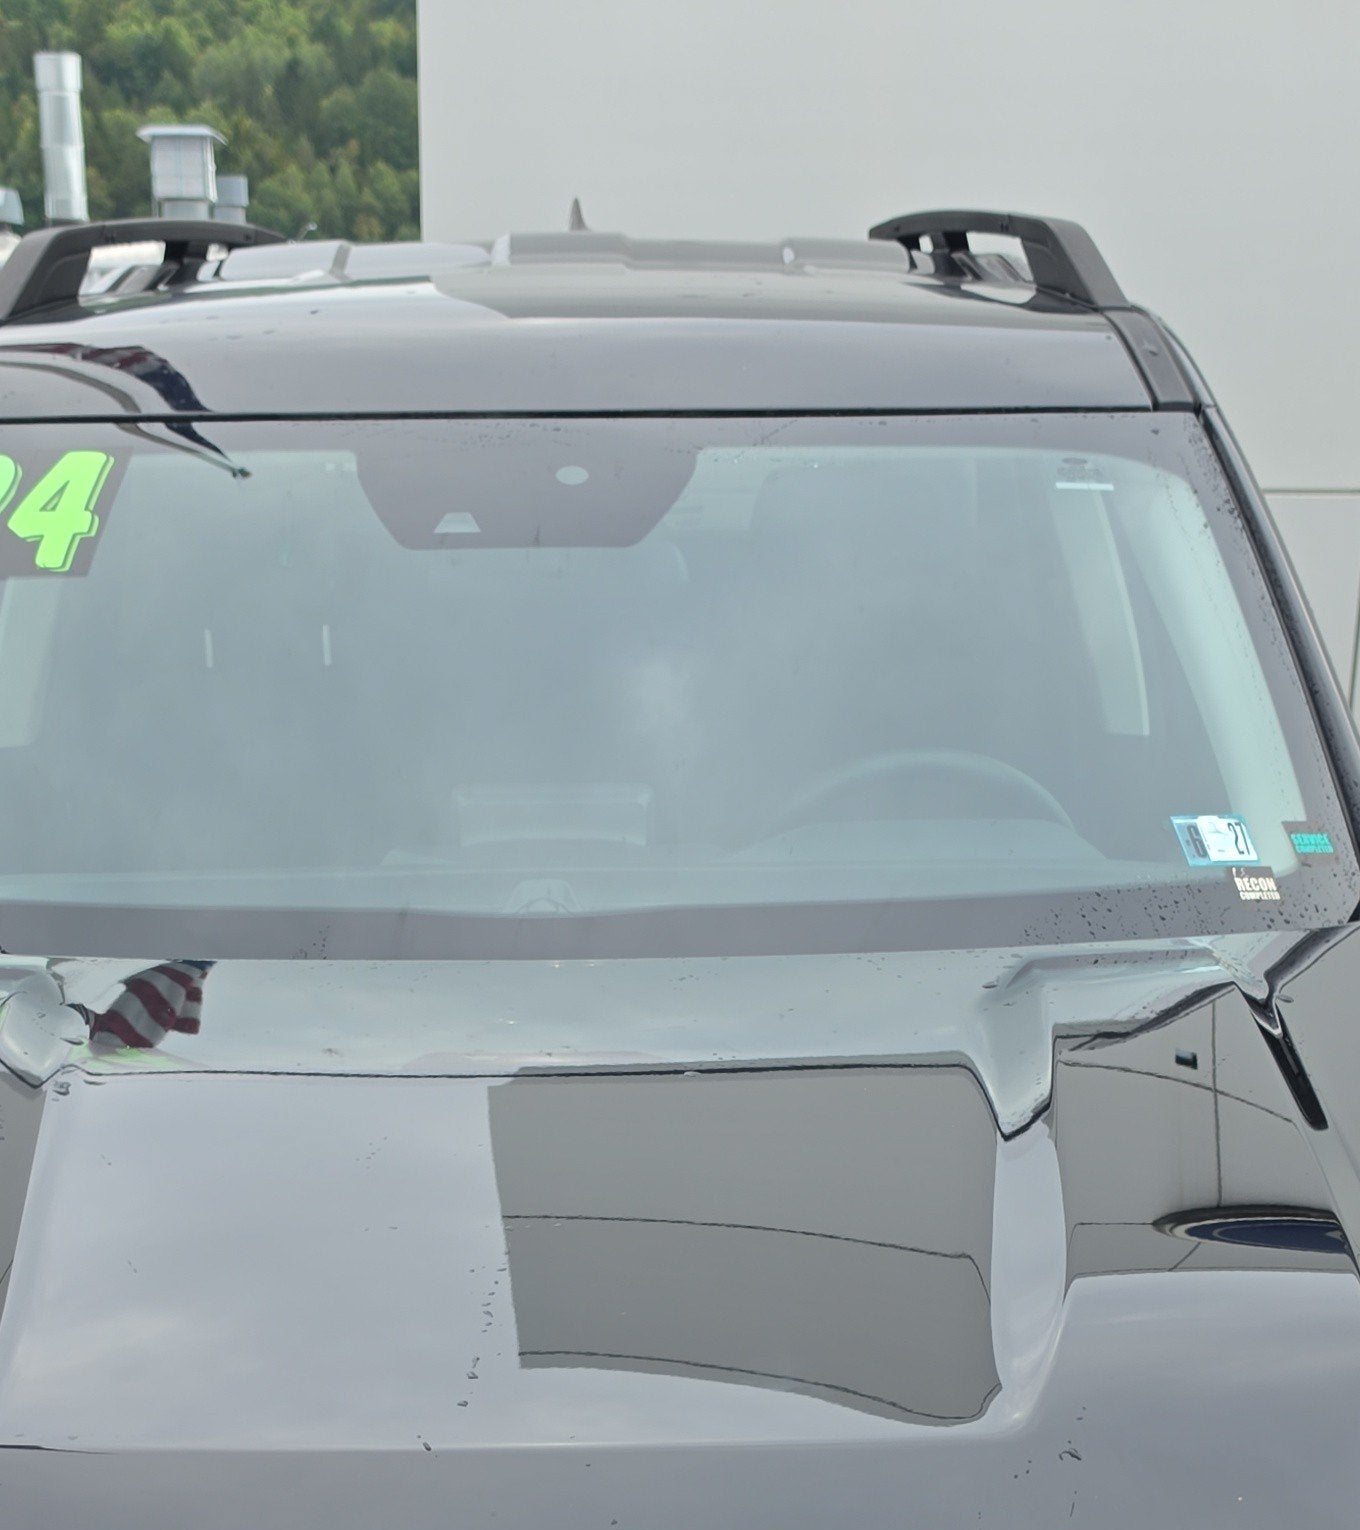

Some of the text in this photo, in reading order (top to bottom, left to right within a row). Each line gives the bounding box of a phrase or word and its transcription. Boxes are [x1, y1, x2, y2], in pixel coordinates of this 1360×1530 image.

[1226, 822, 1251, 856] 27
[1233, 877, 1277, 892] RECON
[1238, 891, 1281, 901] COMPLETED
